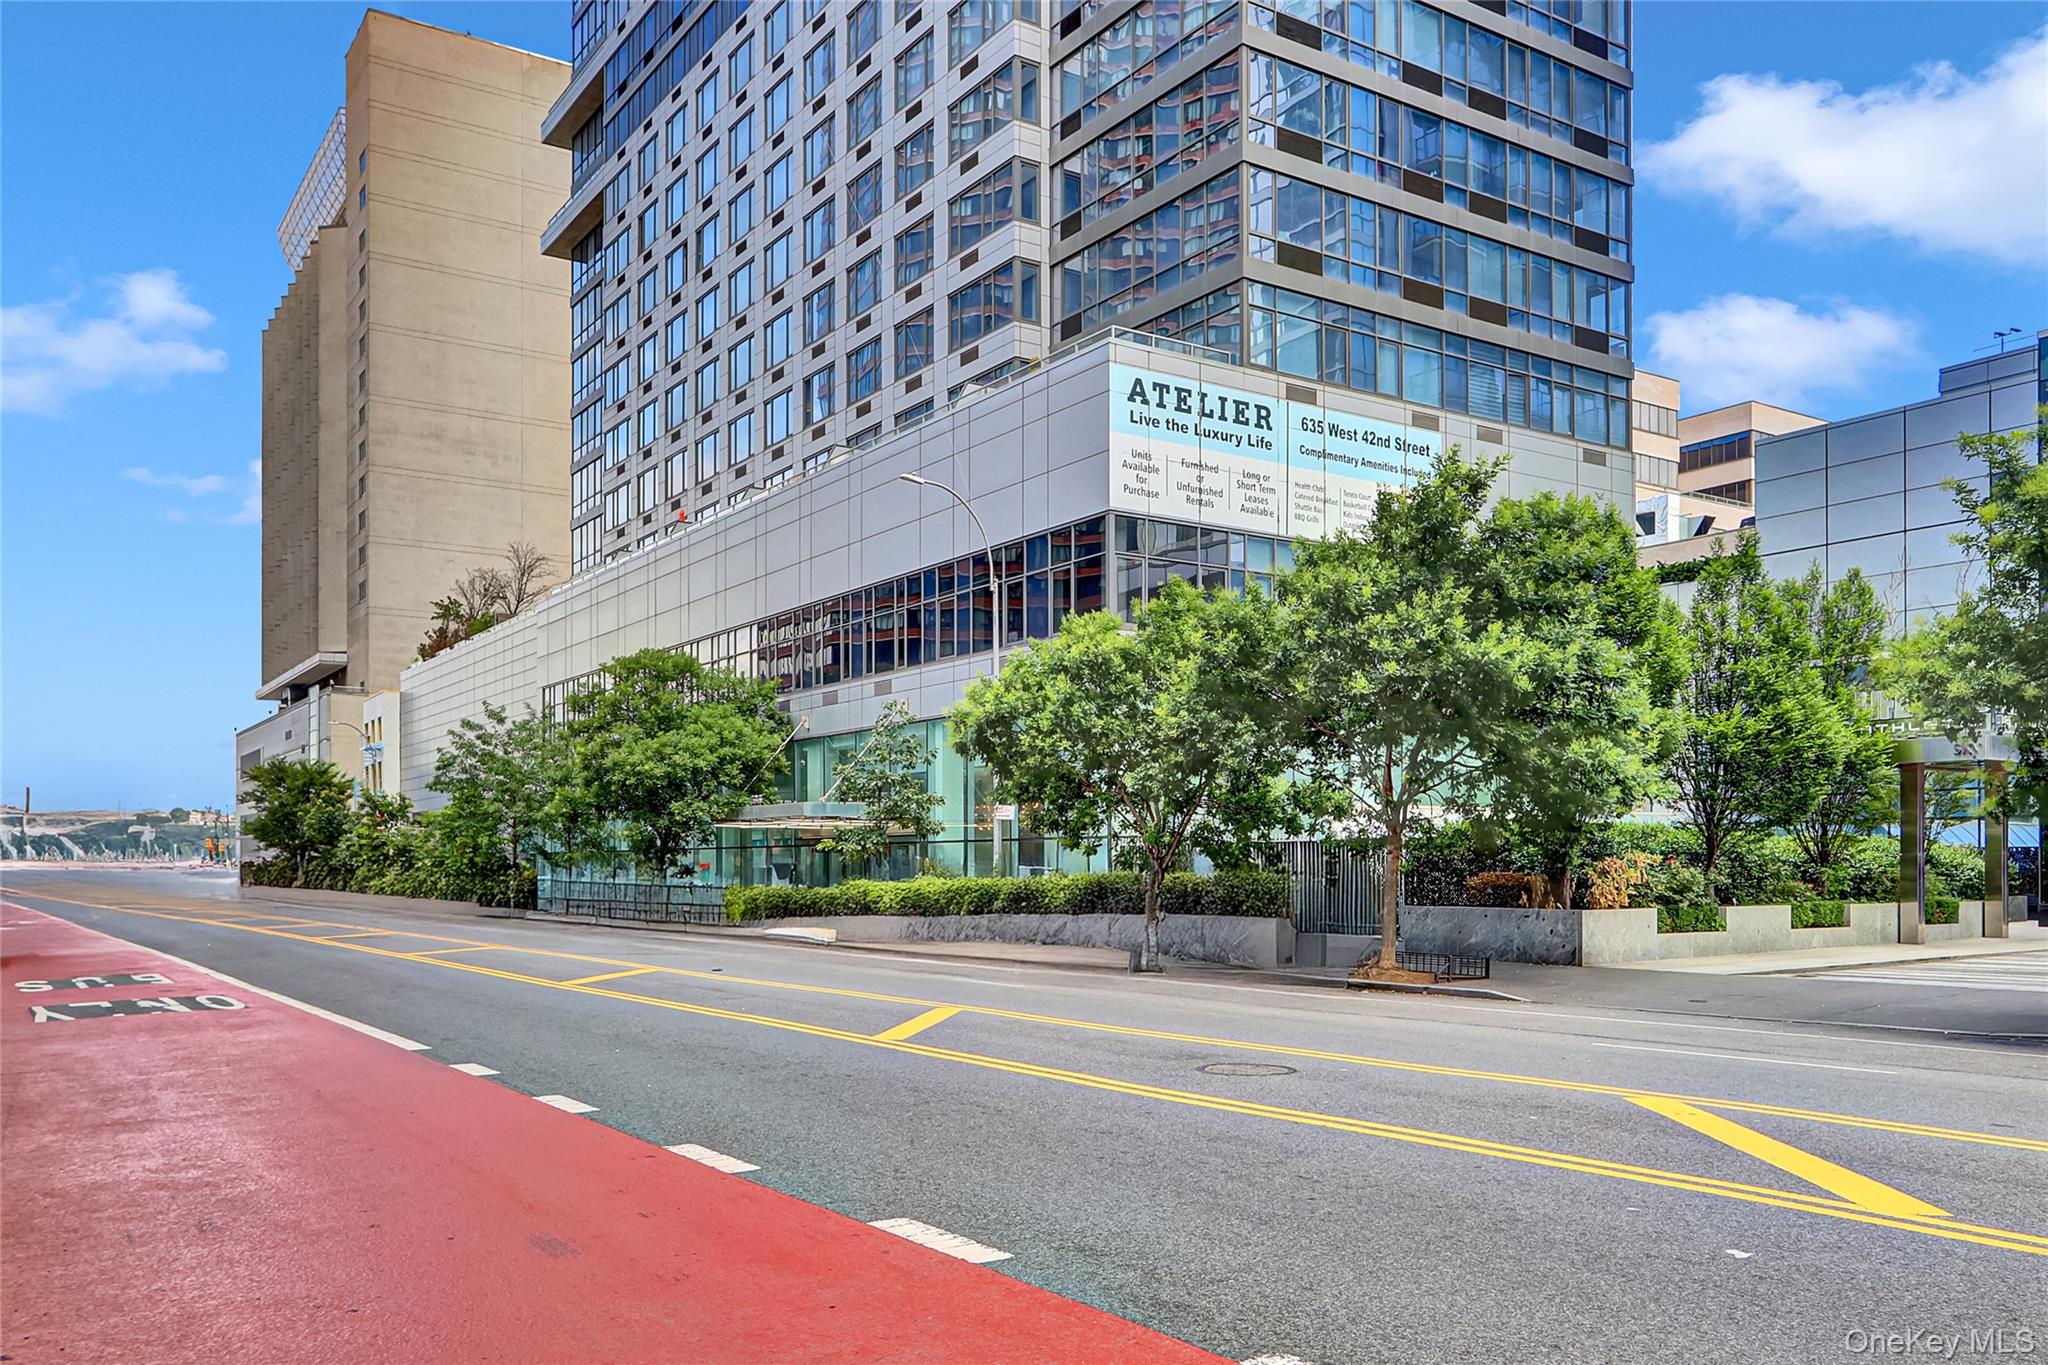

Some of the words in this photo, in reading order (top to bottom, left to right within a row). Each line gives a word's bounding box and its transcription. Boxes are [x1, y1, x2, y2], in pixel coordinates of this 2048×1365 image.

[1127, 377, 1273, 431] ATELIER
[1129, 410, 1160, 428] Live
[1165, 418, 1189, 434] the
[1194, 423, 1243, 447] Luxury
[1247, 434, 1273, 450] Life
[1301, 416, 1324, 434] 635
[1328, 422, 1358, 442] West
[1361, 430, 1391, 449] 42nd
[1394, 436, 1430, 457] Street
[1131, 448, 1152, 461] Units
[1122, 459, 1160, 475] Available
[1181, 458, 1219, 474] Furnished
[1361, 457, 1399, 474] Amenities
[1136, 473, 1148, 485] for
[1196, 475, 1204, 483] or
[1242, 469, 1261, 483] Long
[1263, 474, 1270, 482] or
[1123, 483, 1160, 499] Purchase
[1176, 481, 1223, 498] Unfurnished
[1236, 479, 1256, 491] Short
[1258, 483, 1276, 495] Term
[1185, 494, 1214, 508] Rentals
[1244, 493, 1269, 505] Leases
[30, 994, 246, 1024] ONLY
